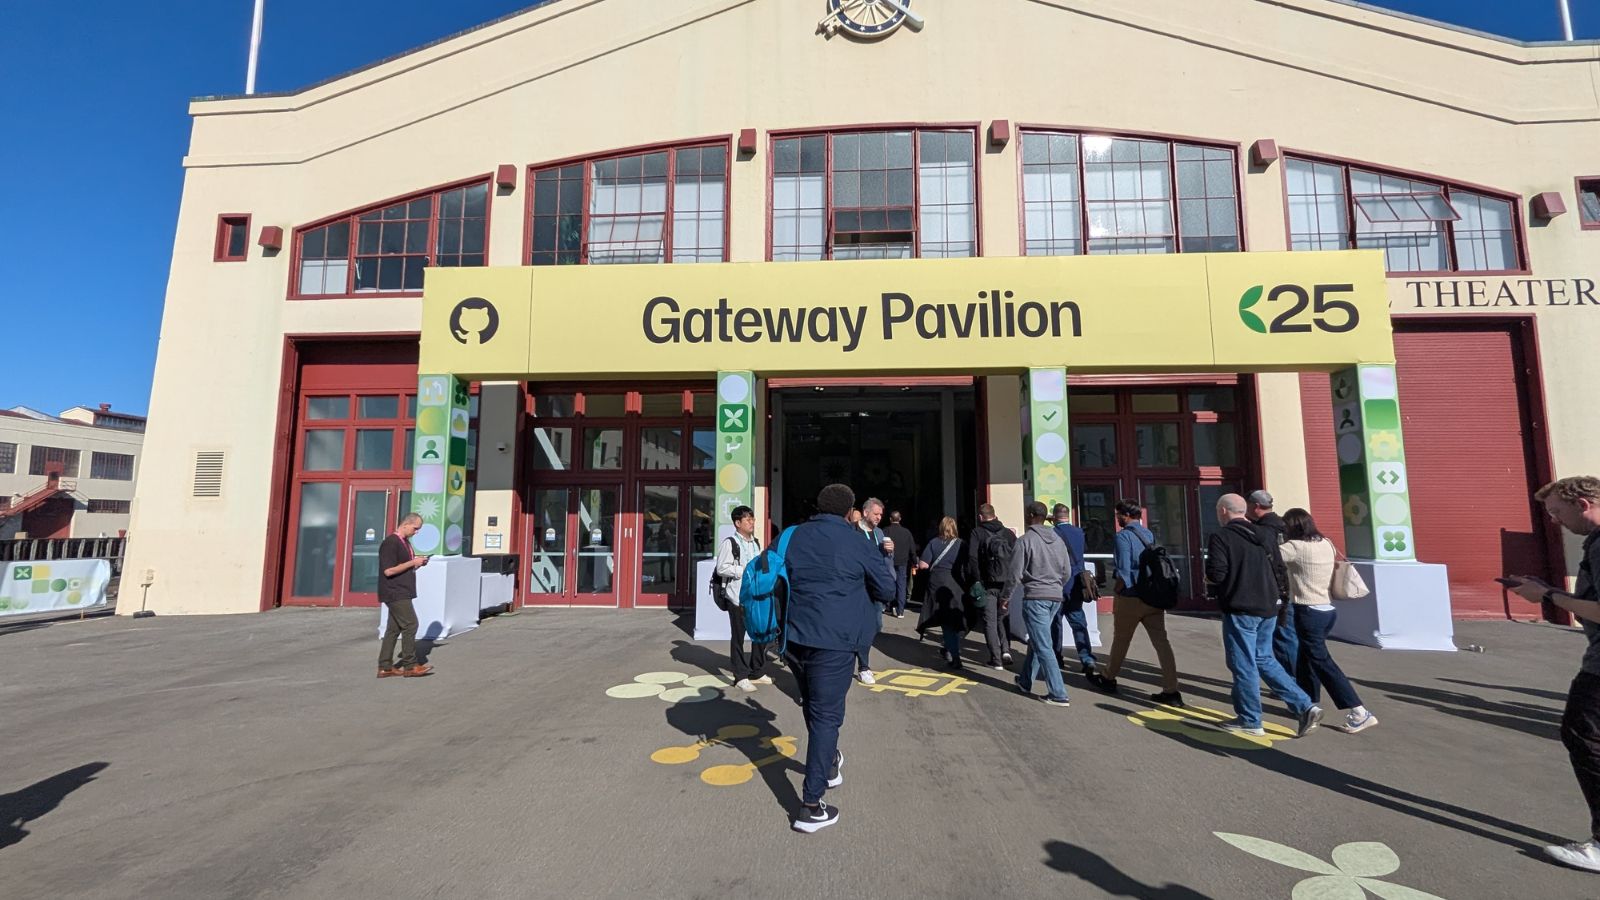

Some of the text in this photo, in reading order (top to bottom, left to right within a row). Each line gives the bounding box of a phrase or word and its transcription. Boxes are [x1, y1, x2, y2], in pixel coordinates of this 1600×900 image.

[1267, 283, 1360, 334] 25
[1406, 277, 1600, 308] THEATER
[642, 289, 1082, 353] Gateway Pavilion
